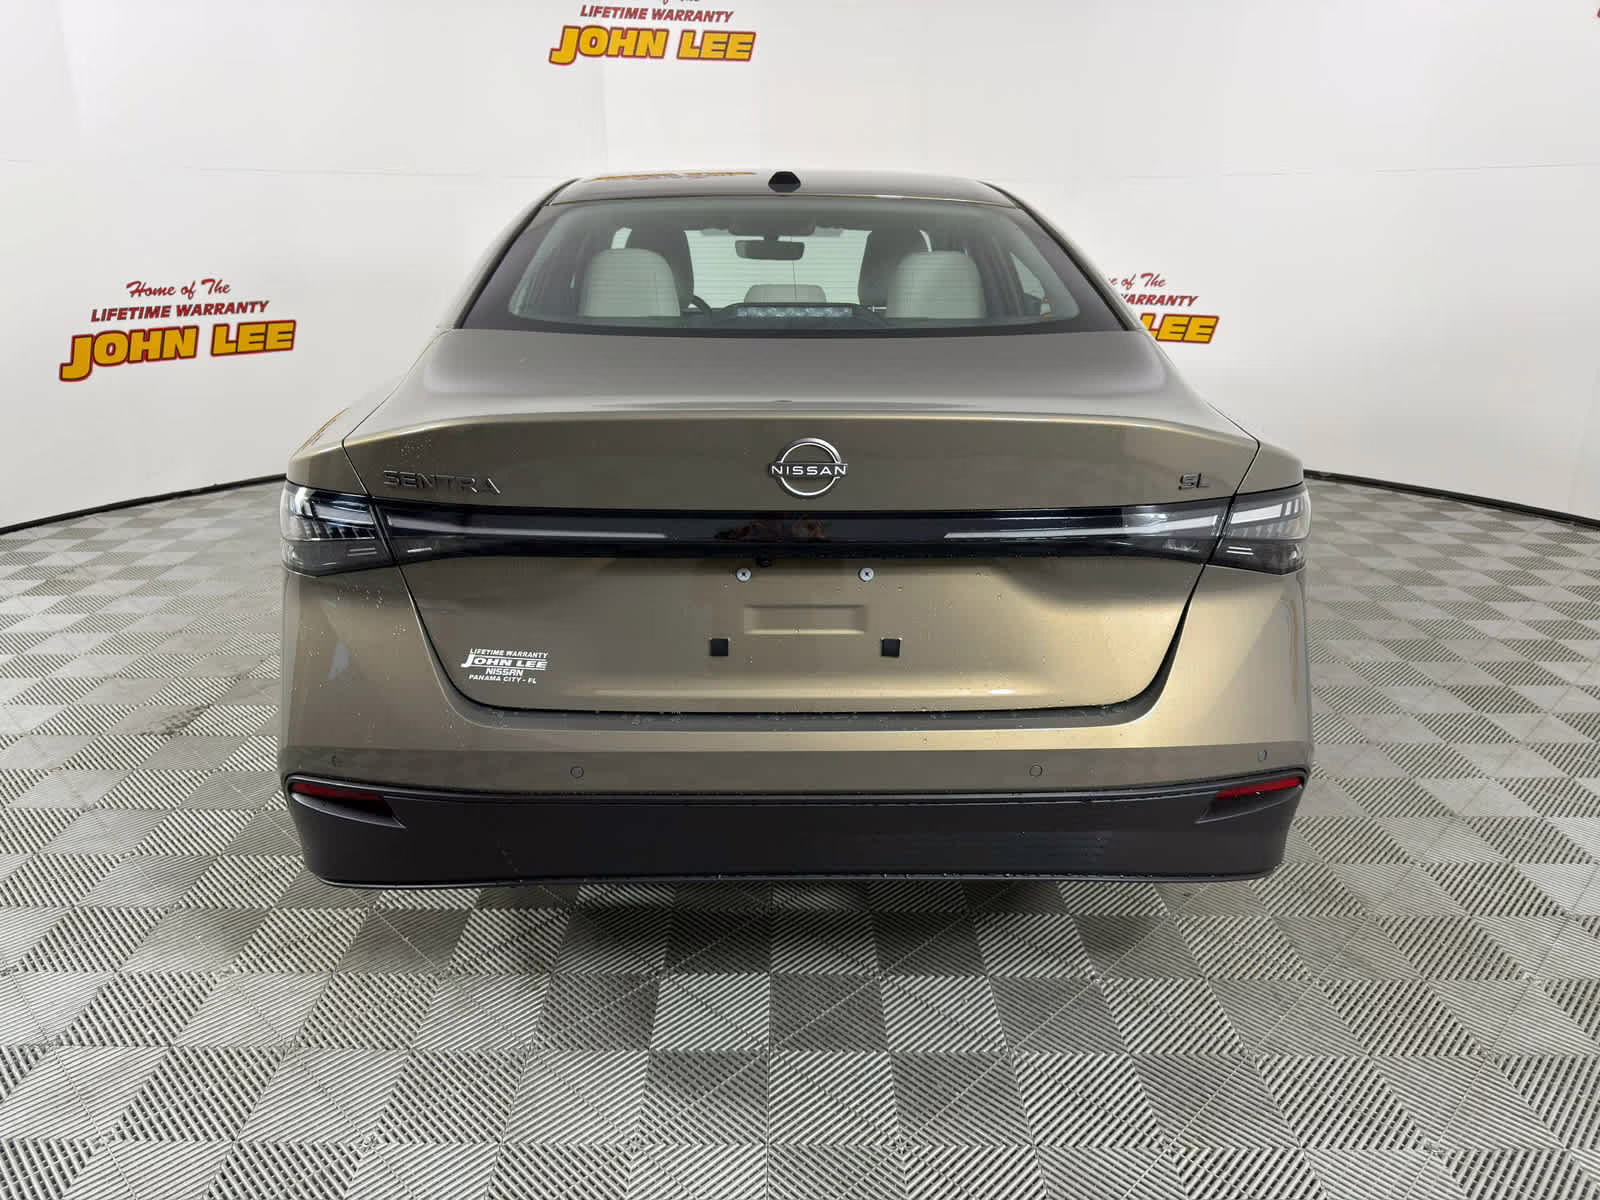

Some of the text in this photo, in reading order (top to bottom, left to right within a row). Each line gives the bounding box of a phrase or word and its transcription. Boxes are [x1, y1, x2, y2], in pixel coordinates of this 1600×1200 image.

[580, 5, 734, 23] LIFETIME WARRANTY
[549, 26, 756, 65] JOHN LEE
[126, 278, 230, 300] Home of The
[1121, 273, 1137, 290] of
[1140, 272, 1167, 288] The
[91, 300, 269, 322] LIFETIME WARRANTY
[59, 319, 296, 382] JOHN LEE
[771, 465, 846, 475] NISSAN
[383, 469, 500, 495] SENTRA
[1178, 473, 1208, 490] SL
[461, 654, 548, 669] JOHN LEE
[485, 668, 524, 676] NISSAN
